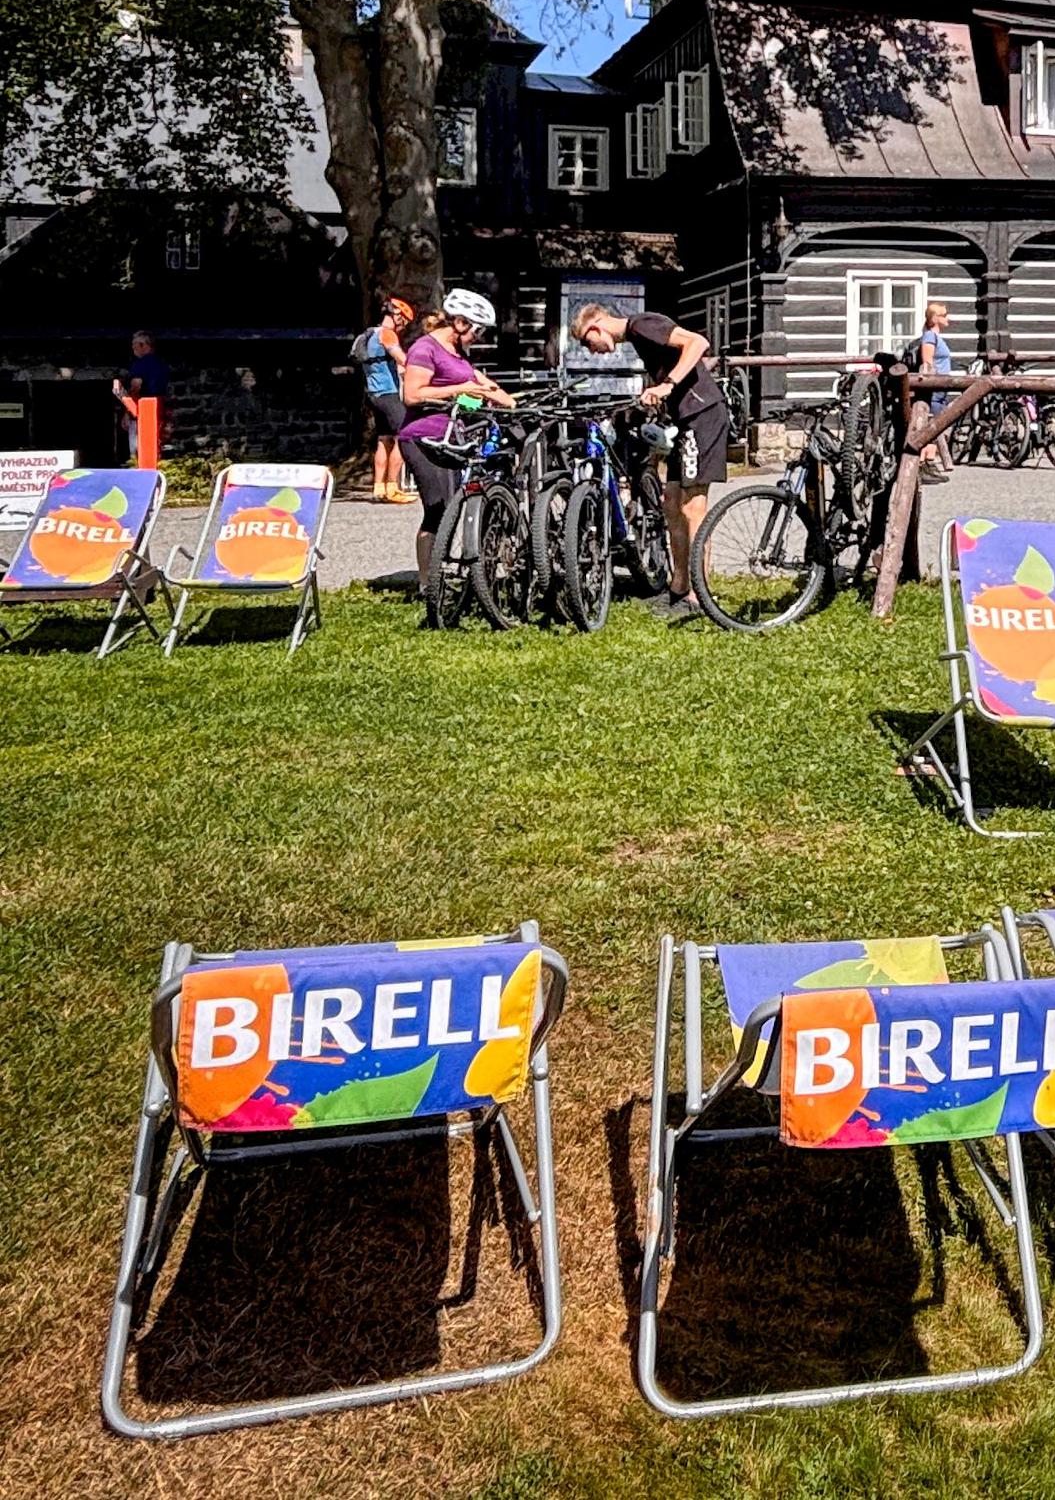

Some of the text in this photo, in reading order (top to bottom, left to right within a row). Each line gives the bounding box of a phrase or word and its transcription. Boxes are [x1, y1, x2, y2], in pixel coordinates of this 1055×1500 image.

[2, 470, 33, 481] POUZE
[35, 517, 135, 543] BIRELL
[219, 520, 310, 541] BIRELL
[191, 975, 521, 1069] BIRELL
